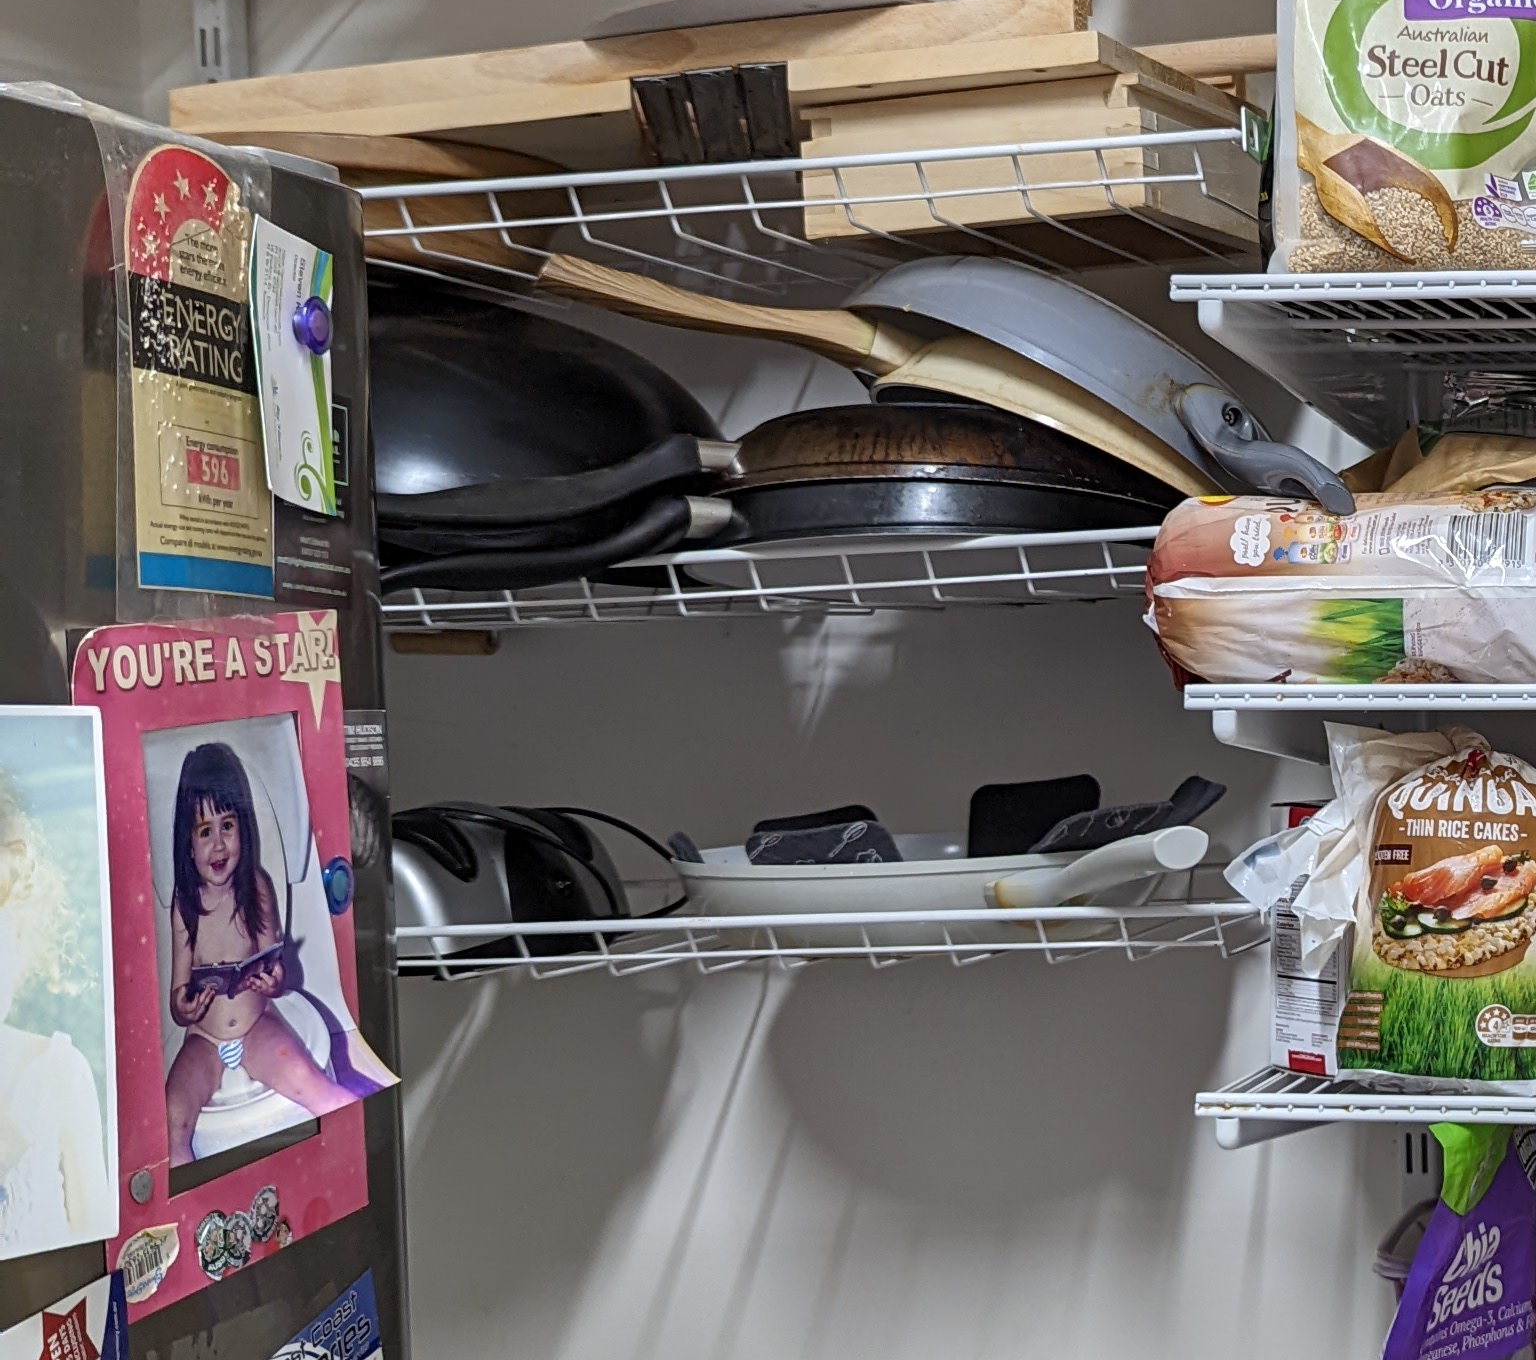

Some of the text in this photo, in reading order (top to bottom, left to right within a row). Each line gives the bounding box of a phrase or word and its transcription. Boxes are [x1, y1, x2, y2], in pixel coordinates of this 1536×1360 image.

[1397, 25, 1490, 44] Australian
[1365, 44, 1510, 87] Steel Cut
[1410, 83, 1466, 107] Oats
[161, 291, 242, 343] ENERGY
[168, 335, 244, 384] RATING
[201, 460, 229, 486] 596
[86, 627, 337, 695] YOU'RE A STAR!
[1406, 818, 1520, 842] THIN RICE CAKES
[1392, 850, 1410, 862] FREE
[1442, 1221, 1501, 1283] Chia
[1426, 1261, 1504, 1333] Seeds
[311, 1289, 358, 1349] Coast
[58, 1324, 72, 1353] DAYS
[1462, 1324, 1515, 1352] Phosphorus
